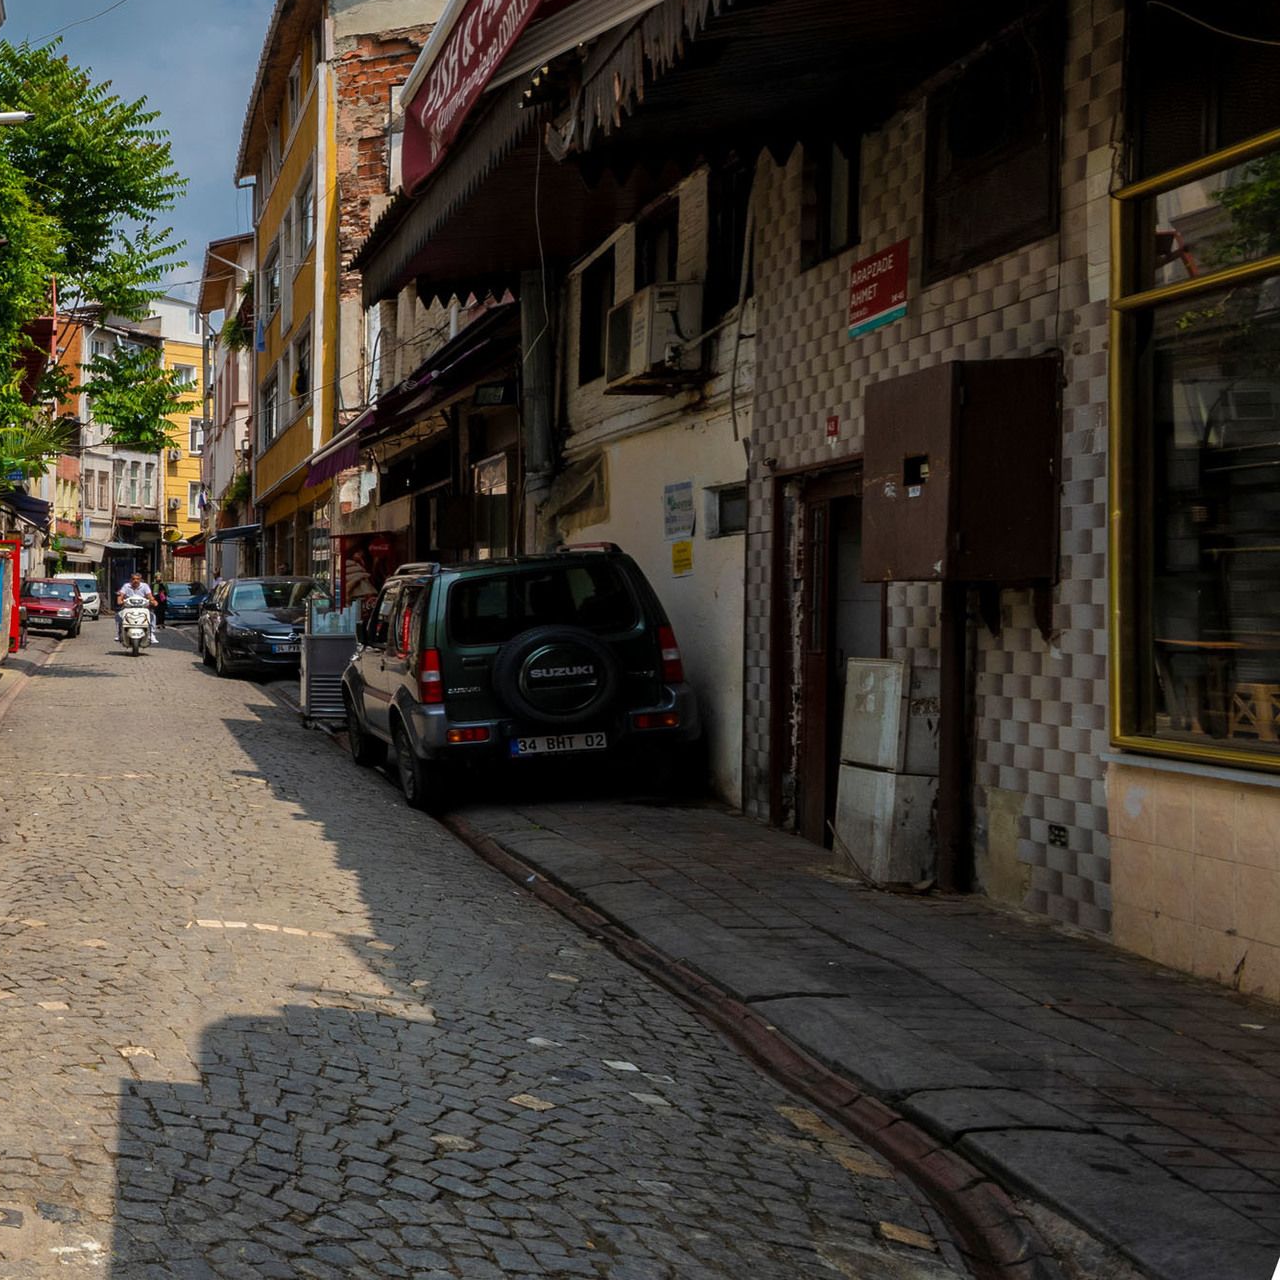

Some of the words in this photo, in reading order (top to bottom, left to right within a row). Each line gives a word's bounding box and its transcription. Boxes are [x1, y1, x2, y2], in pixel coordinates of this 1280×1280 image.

[421, 21, 463, 128] FISH
[849, 253, 894, 287] ARAPZADE
[850, 282, 878, 308] AHMET
[530, 665, 594, 678] SUZUKI
[519, 739, 536, 752] 34
[547, 736, 575, 750] BHT
[585, 734, 605, 748] 02
